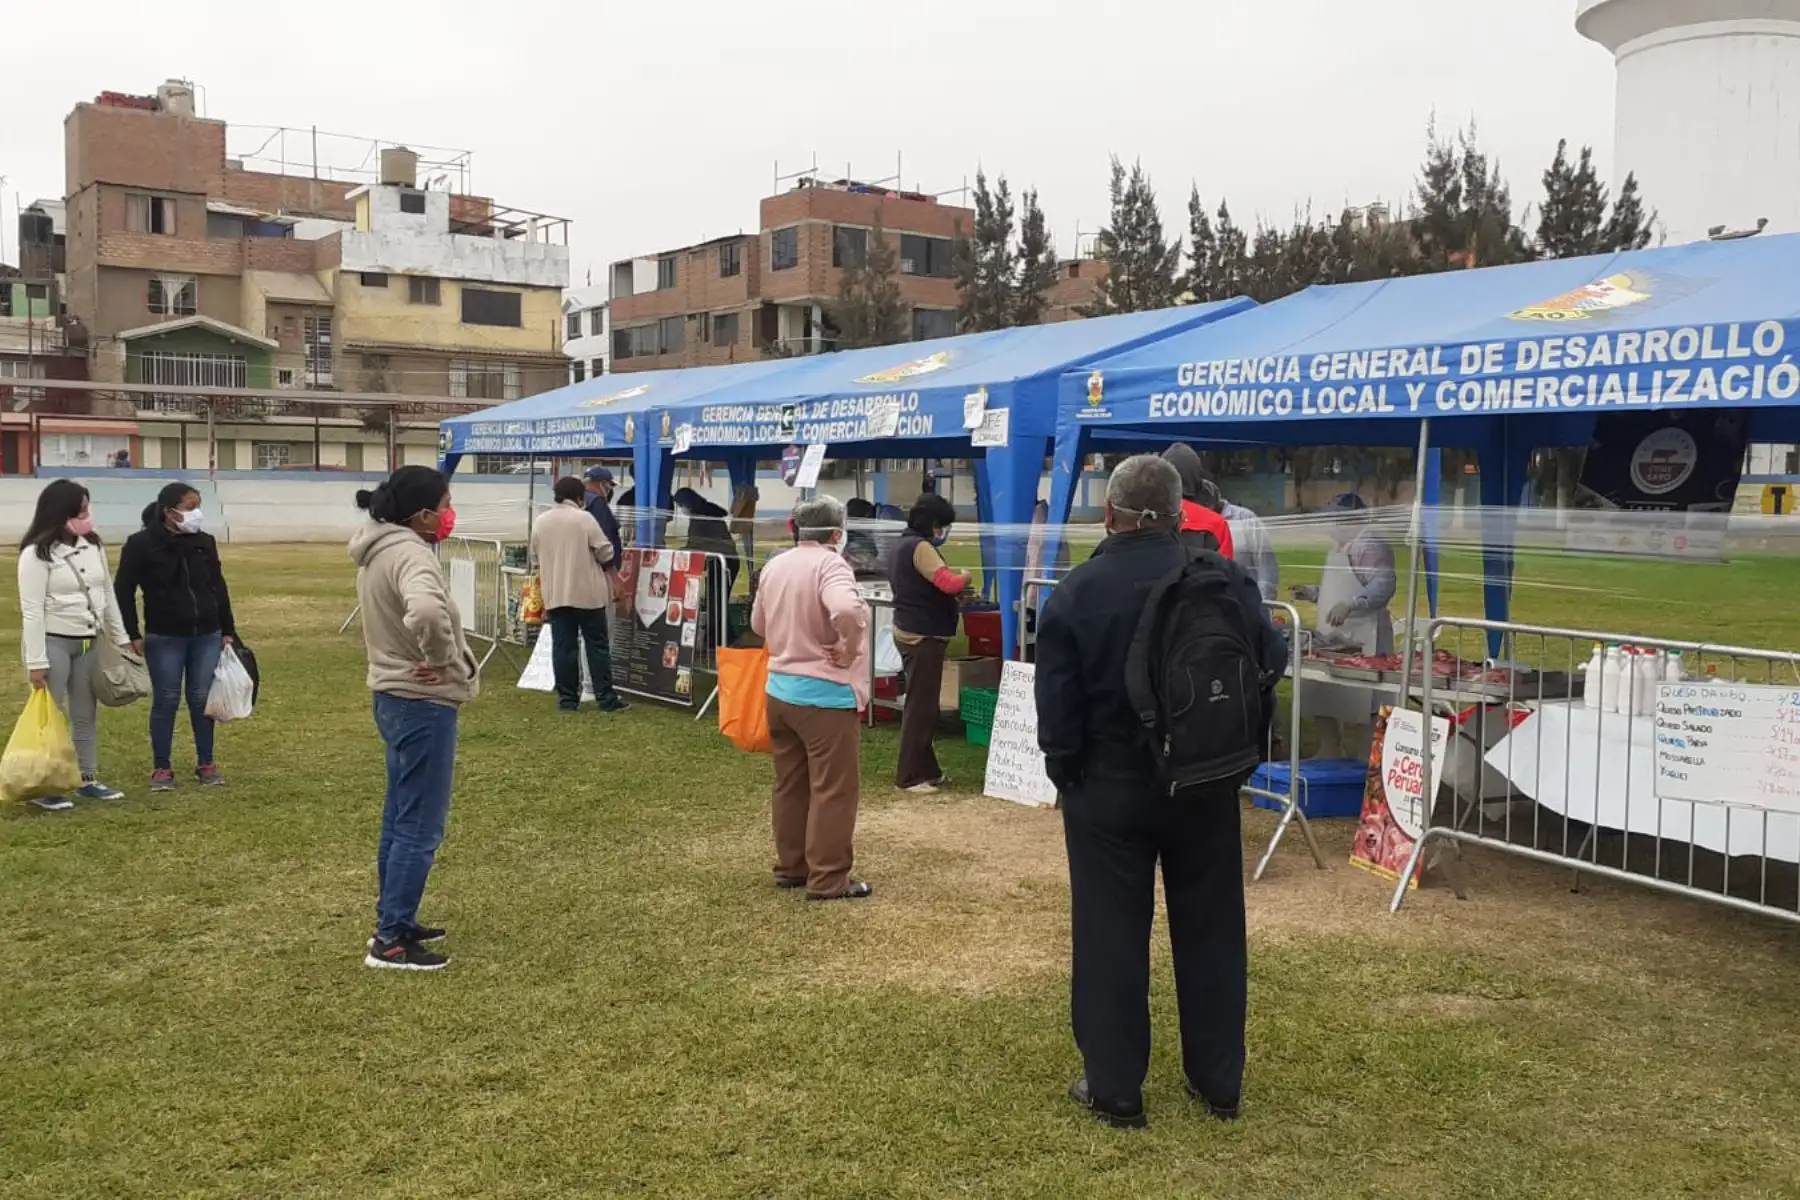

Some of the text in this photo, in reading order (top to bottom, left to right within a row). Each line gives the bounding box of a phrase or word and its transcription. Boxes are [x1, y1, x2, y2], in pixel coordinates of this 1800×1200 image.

[1178, 320, 1784, 387] GERENCIA GENERAL DE DESARROLLO
[1149, 354, 1799, 417] ECONÓMICO LOCAL Y COMERCIALIZACIÓ
[702, 404, 753, 422] GERENCIA
[756, 402, 807, 422] GENAL
[811, 401, 829, 419] DE
[692, 422, 750, 443] ECONÓMICO
[753, 424, 784, 442] LOCA
[802, 411, 933, 441] COMERCIACIÓN
[1771, 487, 1786, 514] T
[1401, 755, 1424, 778] Cer
[1387, 769, 1424, 795] Perua
